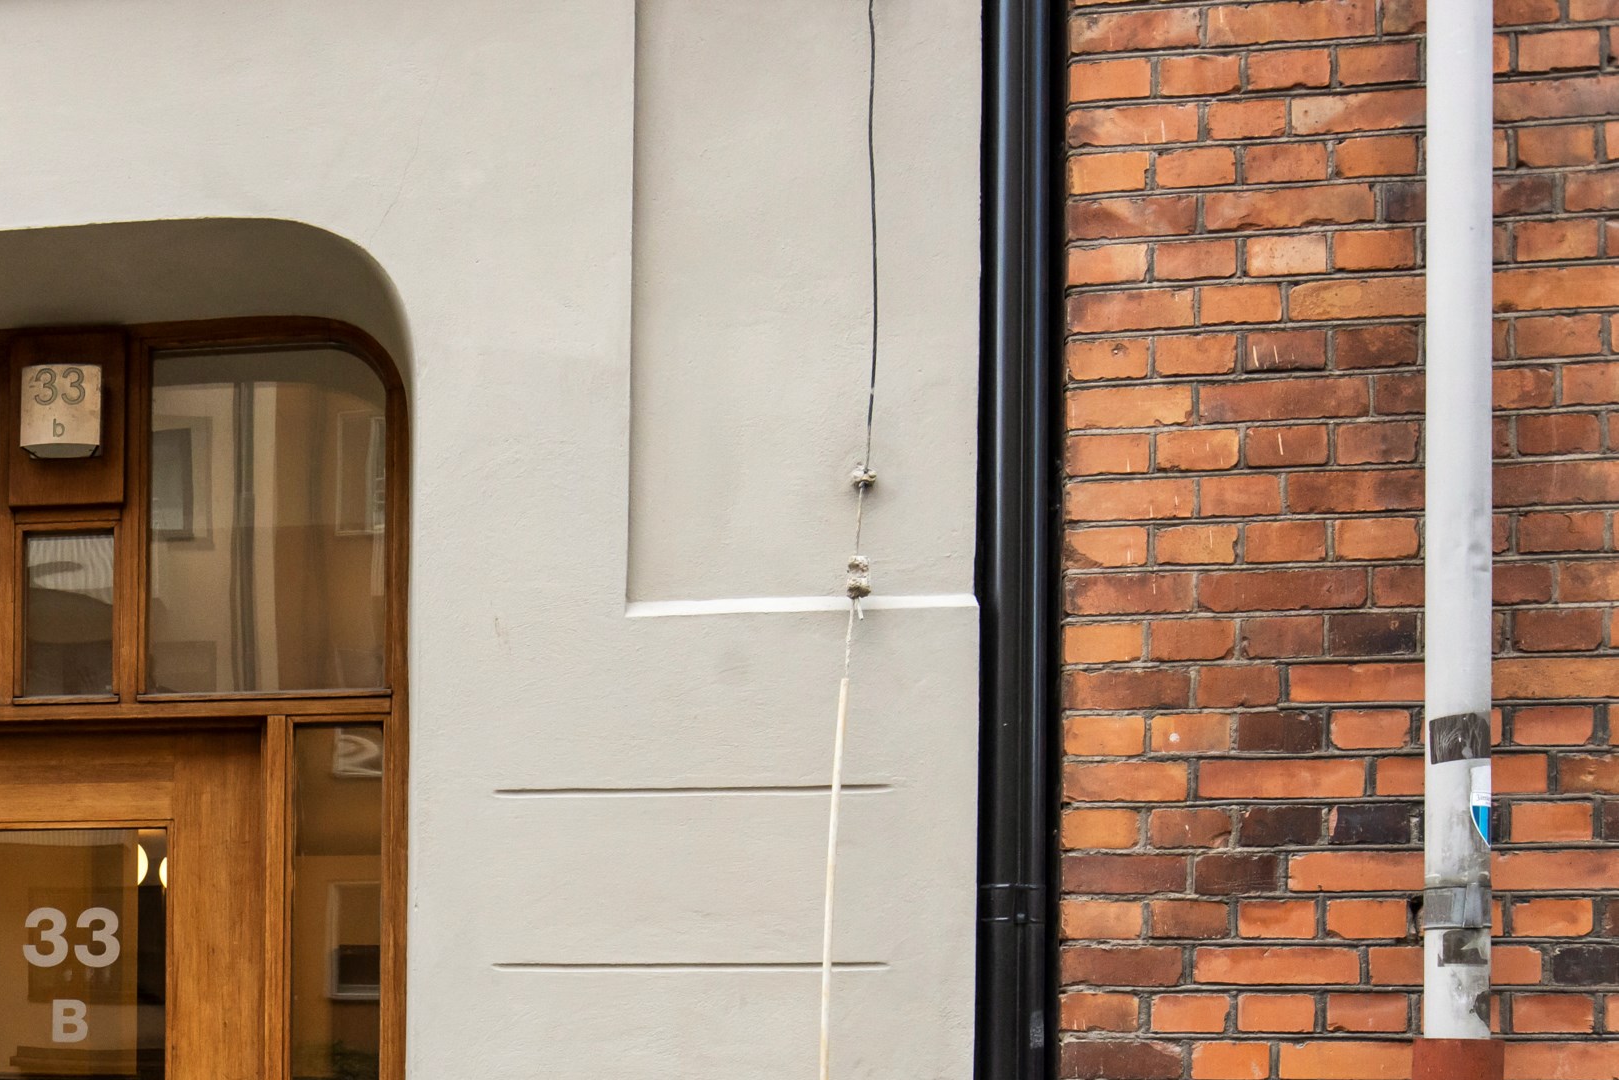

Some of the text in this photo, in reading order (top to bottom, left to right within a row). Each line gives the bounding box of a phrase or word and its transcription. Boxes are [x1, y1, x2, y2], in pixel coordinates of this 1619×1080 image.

[34, 367, 85, 406] 33
[52, 418, 65, 437] b
[22, 906, 121, 968] 33
[52, 999, 89, 1042] B
